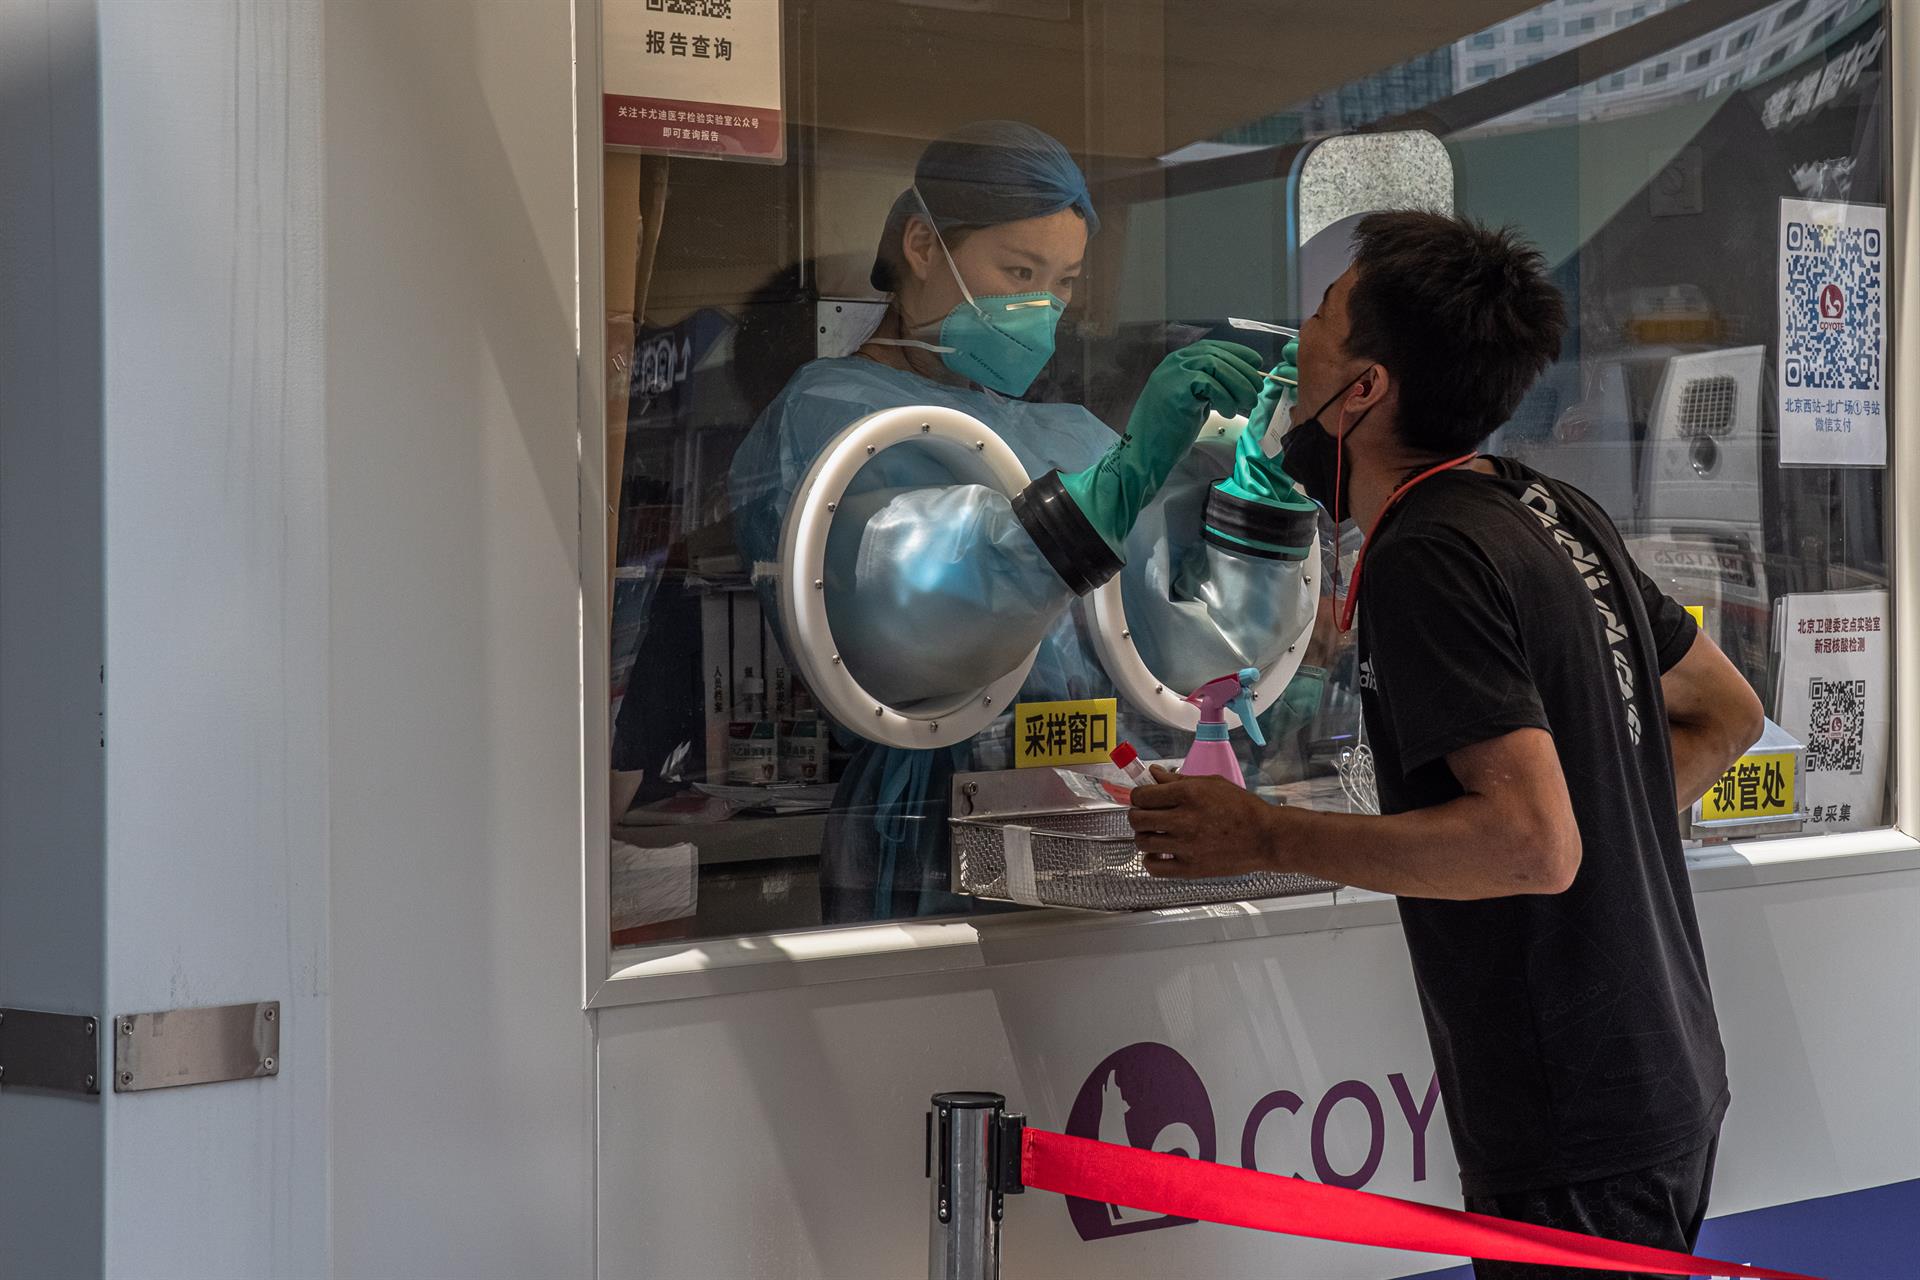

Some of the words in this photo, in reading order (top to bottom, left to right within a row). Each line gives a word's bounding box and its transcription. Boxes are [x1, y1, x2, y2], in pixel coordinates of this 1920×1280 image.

[646, 29, 733, 61] 报告查询
[618, 105, 760, 129] 关注卡尤迪医学检验实验室公众号
[662, 126, 720, 142] 即可查询报告
[1819, 321, 1845, 331] COYOTE
[1815, 417, 1852, 433] 微信支付
[1797, 616, 1881, 635] 北京卫健委定点实验室
[1814, 637, 1866, 654] 新冠核酸检测
[1024, 711, 1108, 757] 采样窗口
[1712, 760, 1786, 813] 领管处
